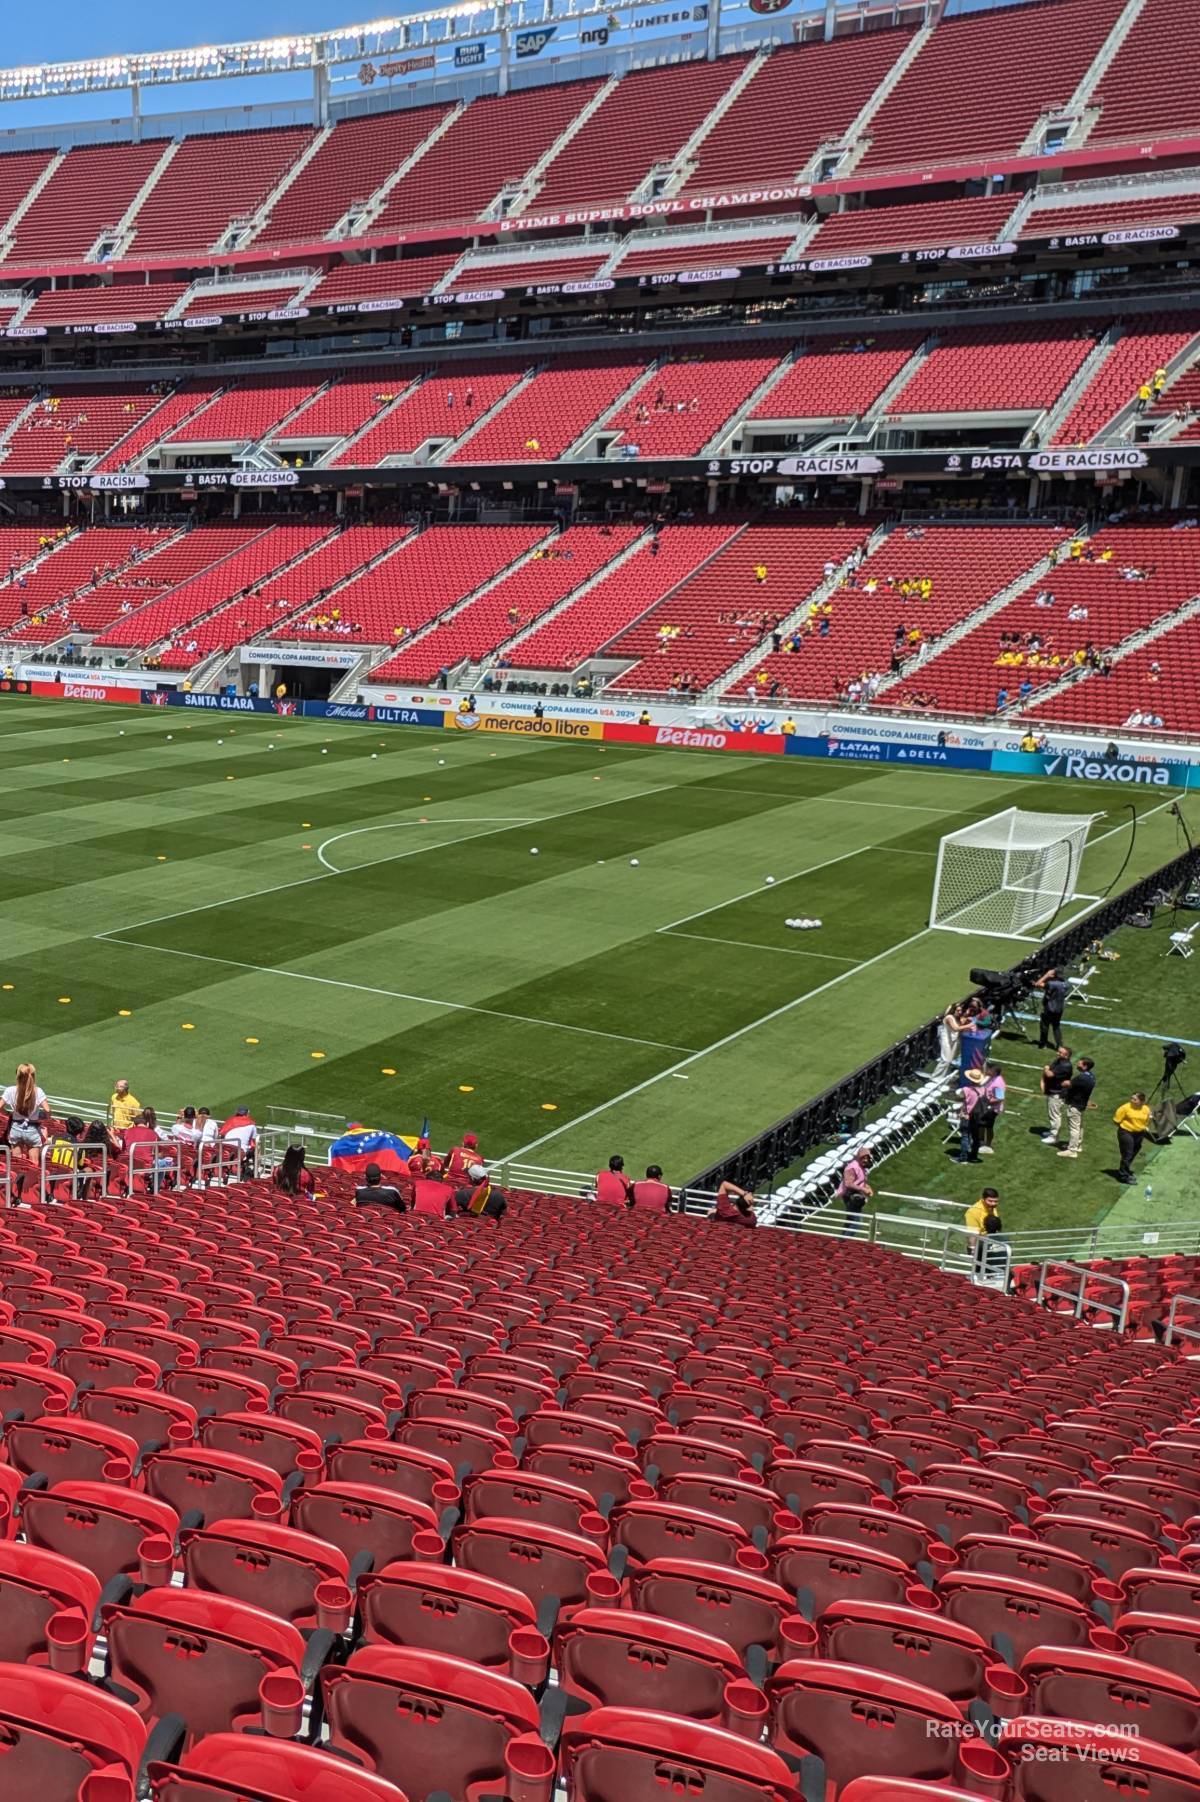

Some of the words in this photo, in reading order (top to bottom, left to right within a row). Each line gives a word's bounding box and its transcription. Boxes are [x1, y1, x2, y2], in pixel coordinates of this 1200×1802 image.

[635, 11, 690, 29] UNITED
[516, 34, 546, 54] SAP
[581, 28, 609, 45] nrg
[459, 46, 480, 56] BUD
[456, 53, 483, 65] LIGHT
[500, 212, 559, 231] 5-TIME
[564, 207, 625, 224] SUPER
[629, 201, 683, 217] BOWL
[689, 186, 812, 210] CHAMPIONS
[1065, 235, 1098, 246] BASTA
[1108, 232, 1123, 242] DE
[1125, 227, 1173, 241] RACISMO
[915, 249, 945, 260] STOP
[959, 243, 1001, 256] RACISM
[779, 262, 806, 272] BASTA
[814, 261, 826, 270] DE
[827, 257, 867, 270] RACISMO
[651, 274, 676, 285] STOP
[687, 269, 722, 281] RACISM
[537, 285, 560, 295] BASTA
[566, 282, 576, 291] DE
[577, 280, 611, 290] RACISMO
[433, 294, 454, 304] STOP
[463, 291, 494, 302] RACISM
[248, 312, 267, 322] STOP
[274, 309, 300, 318] RACISM
[730, 460, 774, 473] STOP
[795, 459, 859, 473] RACISM
[971, 454, 1023, 469] BASTA
[1038, 454, 1062, 467] DE
[1067, 452, 1139, 466] RACISMO
[59, 477, 88, 488] STOP
[100, 476, 136, 488] RACISM
[198, 475, 228, 485] BASTA
[236, 474, 248, 484] DE
[249, 472, 294, 484] RACISMO
[248, 652, 281, 661] CONMEBOL
[282, 653, 298, 661] COPA
[298, 654, 325, 663] AMERICA
[64, 685, 106, 700] Betano
[185, 694, 217, 708] SANTA
[220, 697, 255, 711] CLARA
[325, 703, 367, 721] Michelob
[377, 708, 419, 723] ULTRA
[543, 704, 562, 713] COPA
[563, 706, 599, 716] AMERICA
[599, 709, 615, 718] USA
[616, 709, 635, 718] 2024
[485, 716, 552, 734] mercado
[555, 718, 590, 737] libre
[655, 727, 727, 748] Betano
[832, 725, 879, 738] CONMEBOL
[880, 729, 902, 740] COPA
[902, 731, 938, 743] AMERIC
[963, 738, 984, 748] 2024
[840, 742, 881, 752] LATAM
[840, 752, 880, 760] AIRLINES
[909, 750, 947, 760] DELTA
[1066, 756, 1170, 786] Rexona
